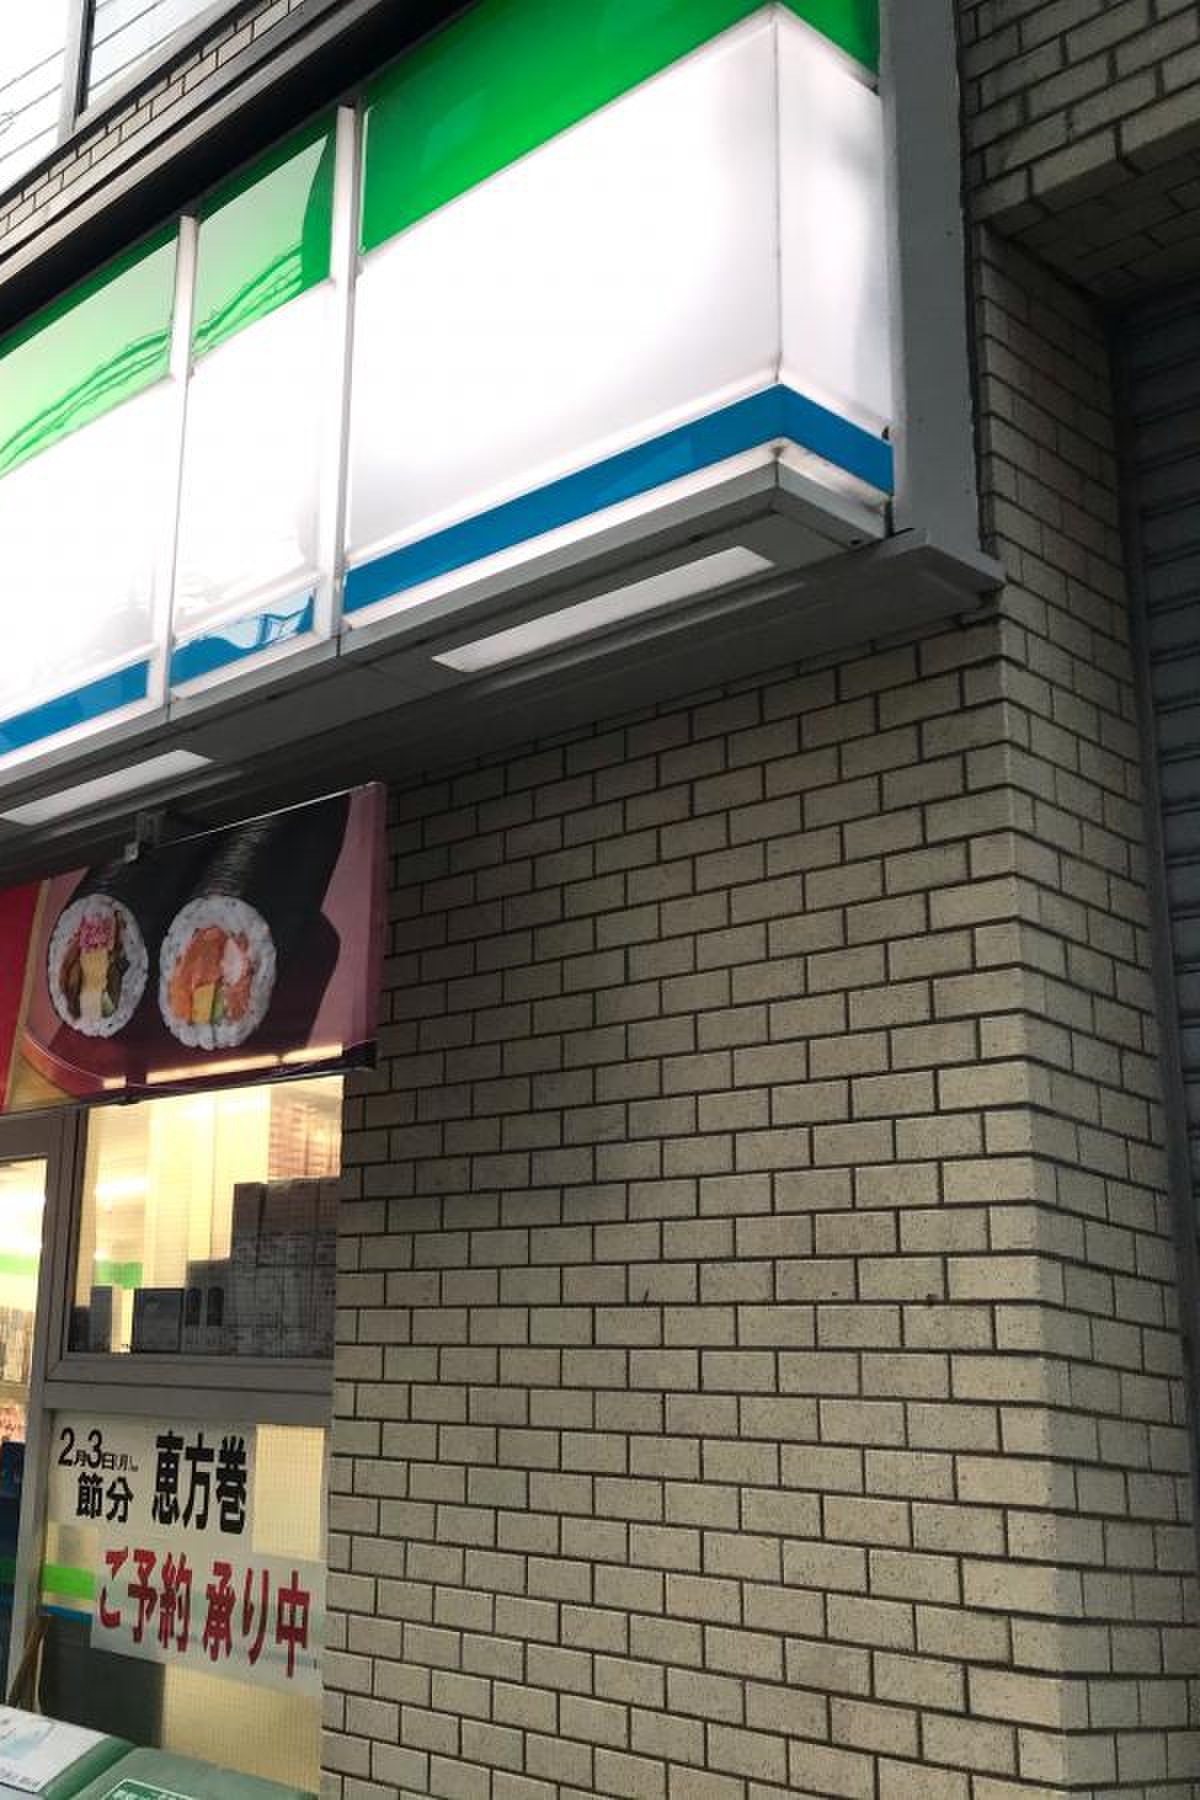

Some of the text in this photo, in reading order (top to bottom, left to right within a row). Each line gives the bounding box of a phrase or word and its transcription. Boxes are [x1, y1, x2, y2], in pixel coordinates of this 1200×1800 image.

[76, 1472, 134, 1523] 節分
[152, 1430, 248, 1535] 恵方巻
